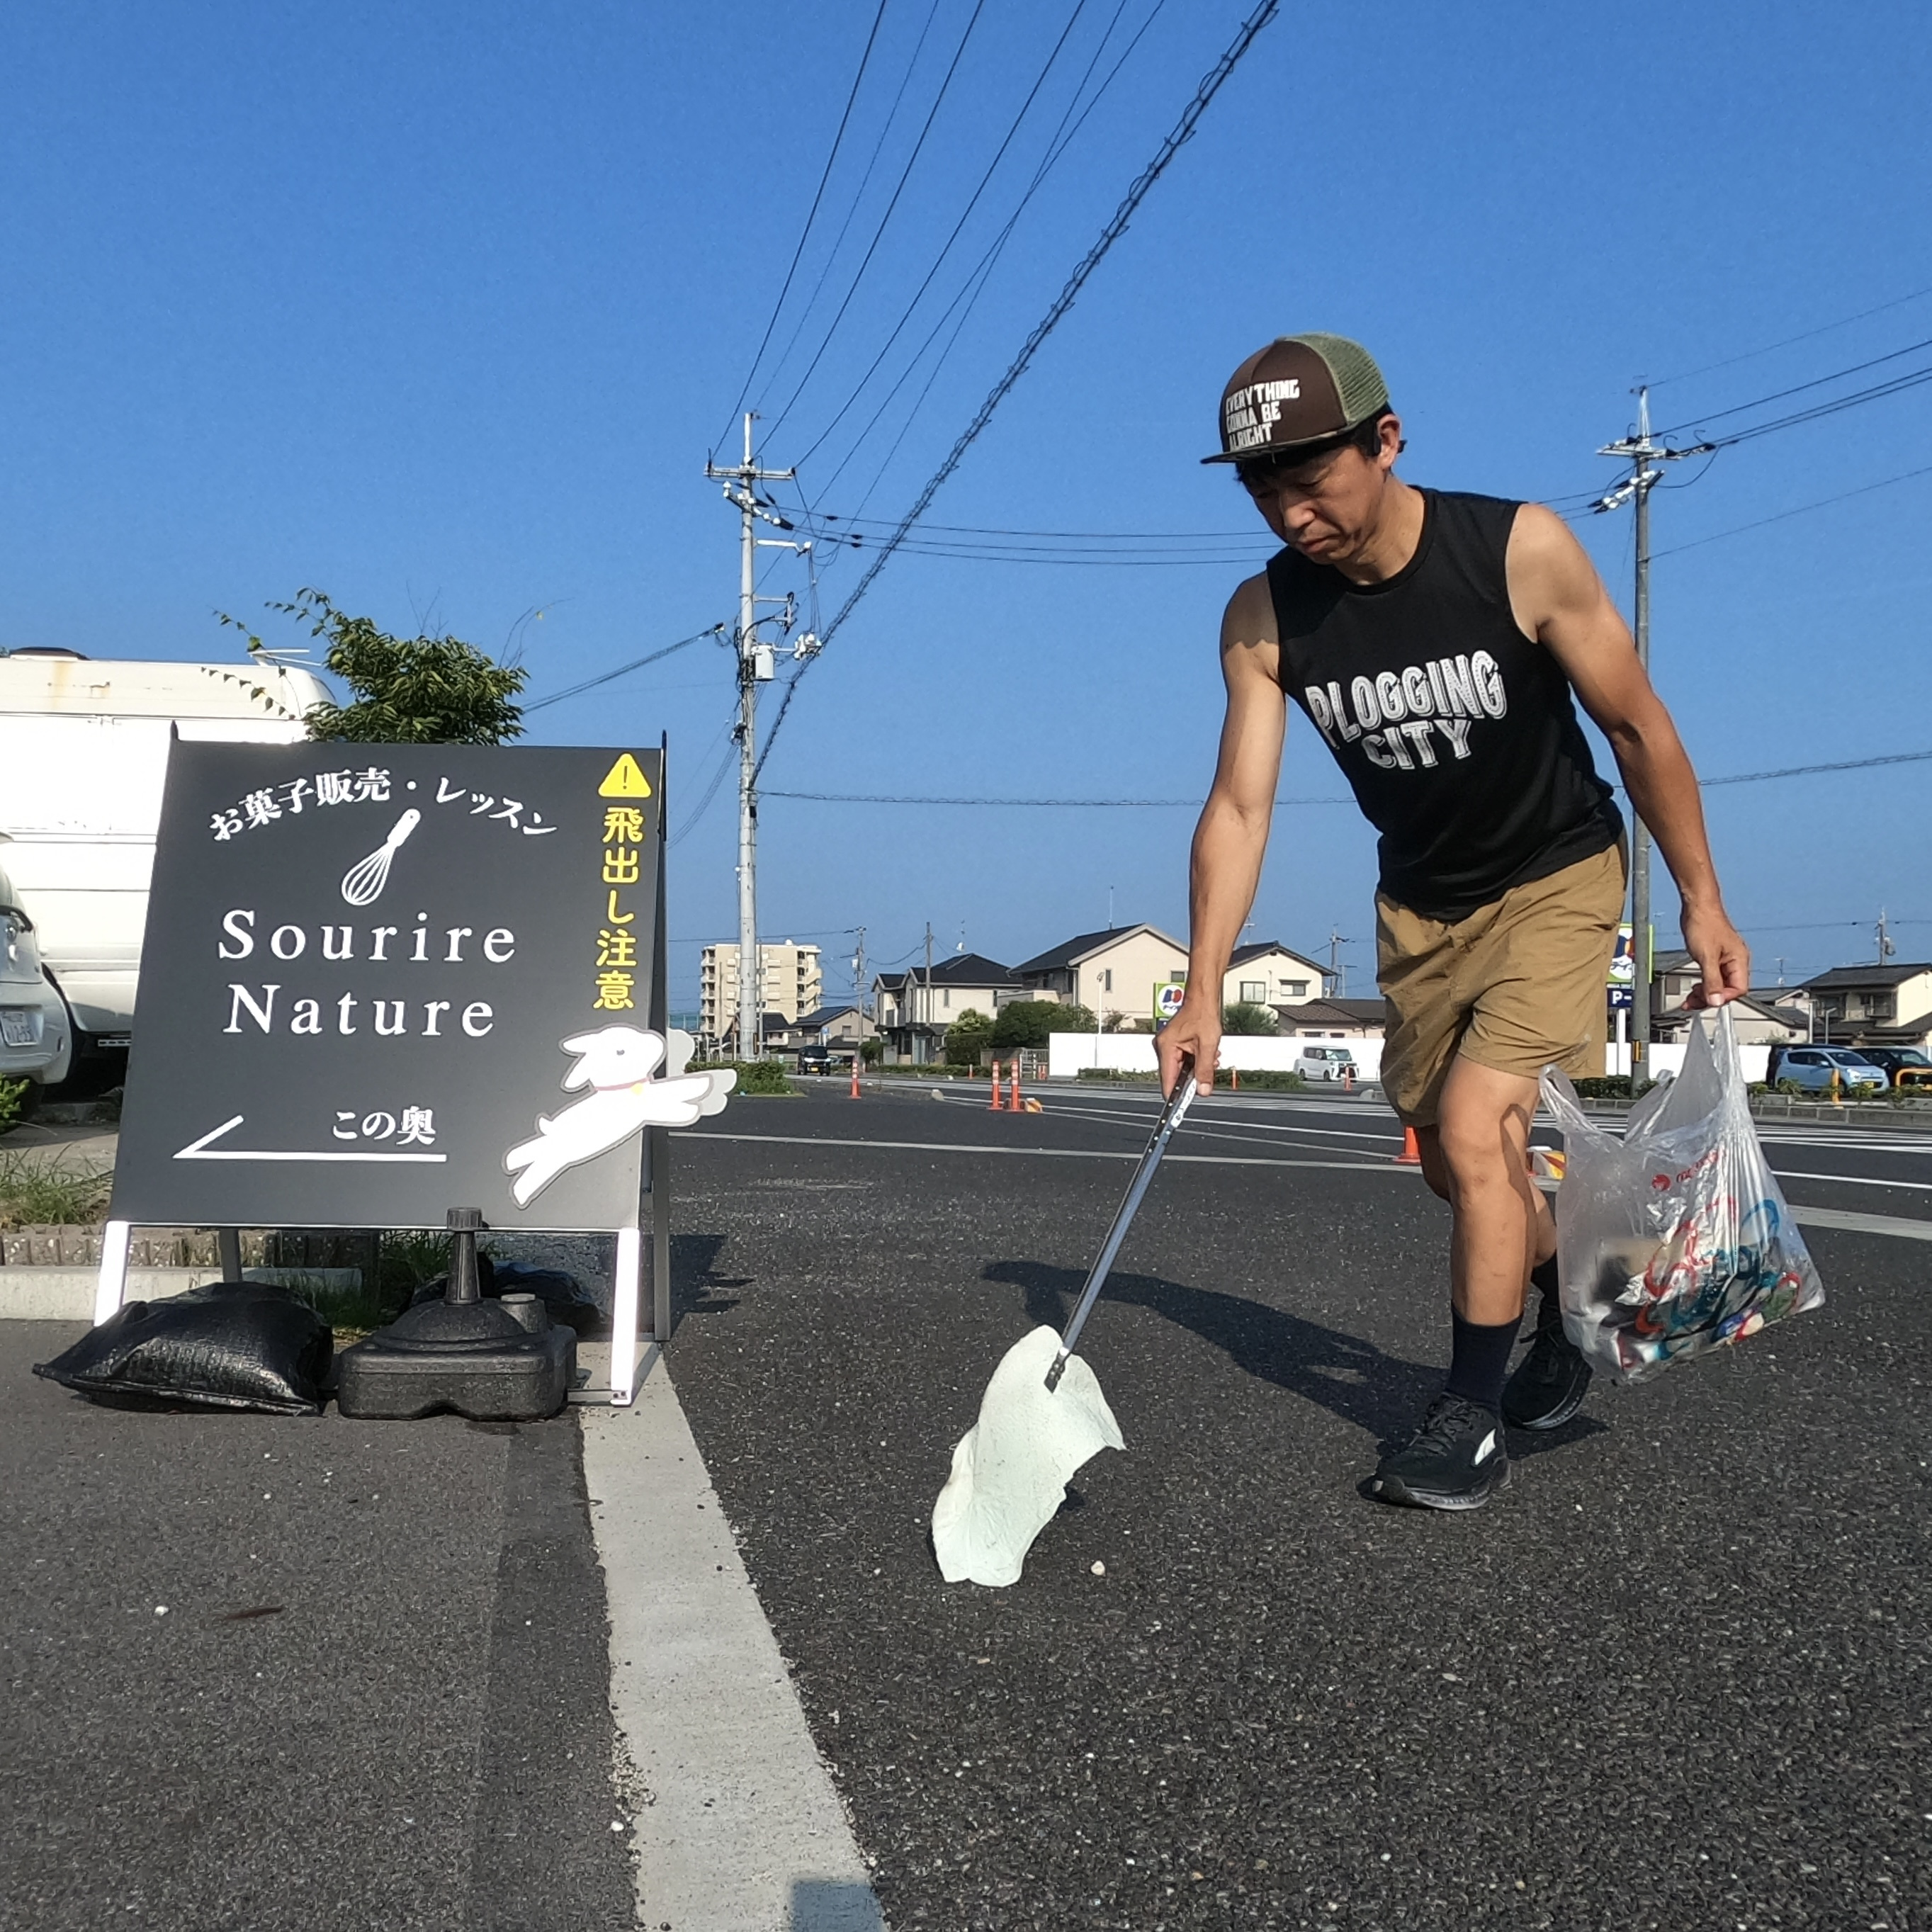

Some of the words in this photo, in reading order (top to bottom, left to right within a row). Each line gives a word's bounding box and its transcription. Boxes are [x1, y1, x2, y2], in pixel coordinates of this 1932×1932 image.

[1226, 378, 1300, 416] EVERYTHING
[1261, 400, 1282, 423] BE
[1305, 650, 1507, 750] PLOGGING
[1361, 718, 1471, 770] CITY
[593, 806, 645, 1011] 飛出し注意
[218, 909, 515, 963] Sourire
[222, 983, 494, 1037] Nature
[332, 1105, 437, 1146] この奥
